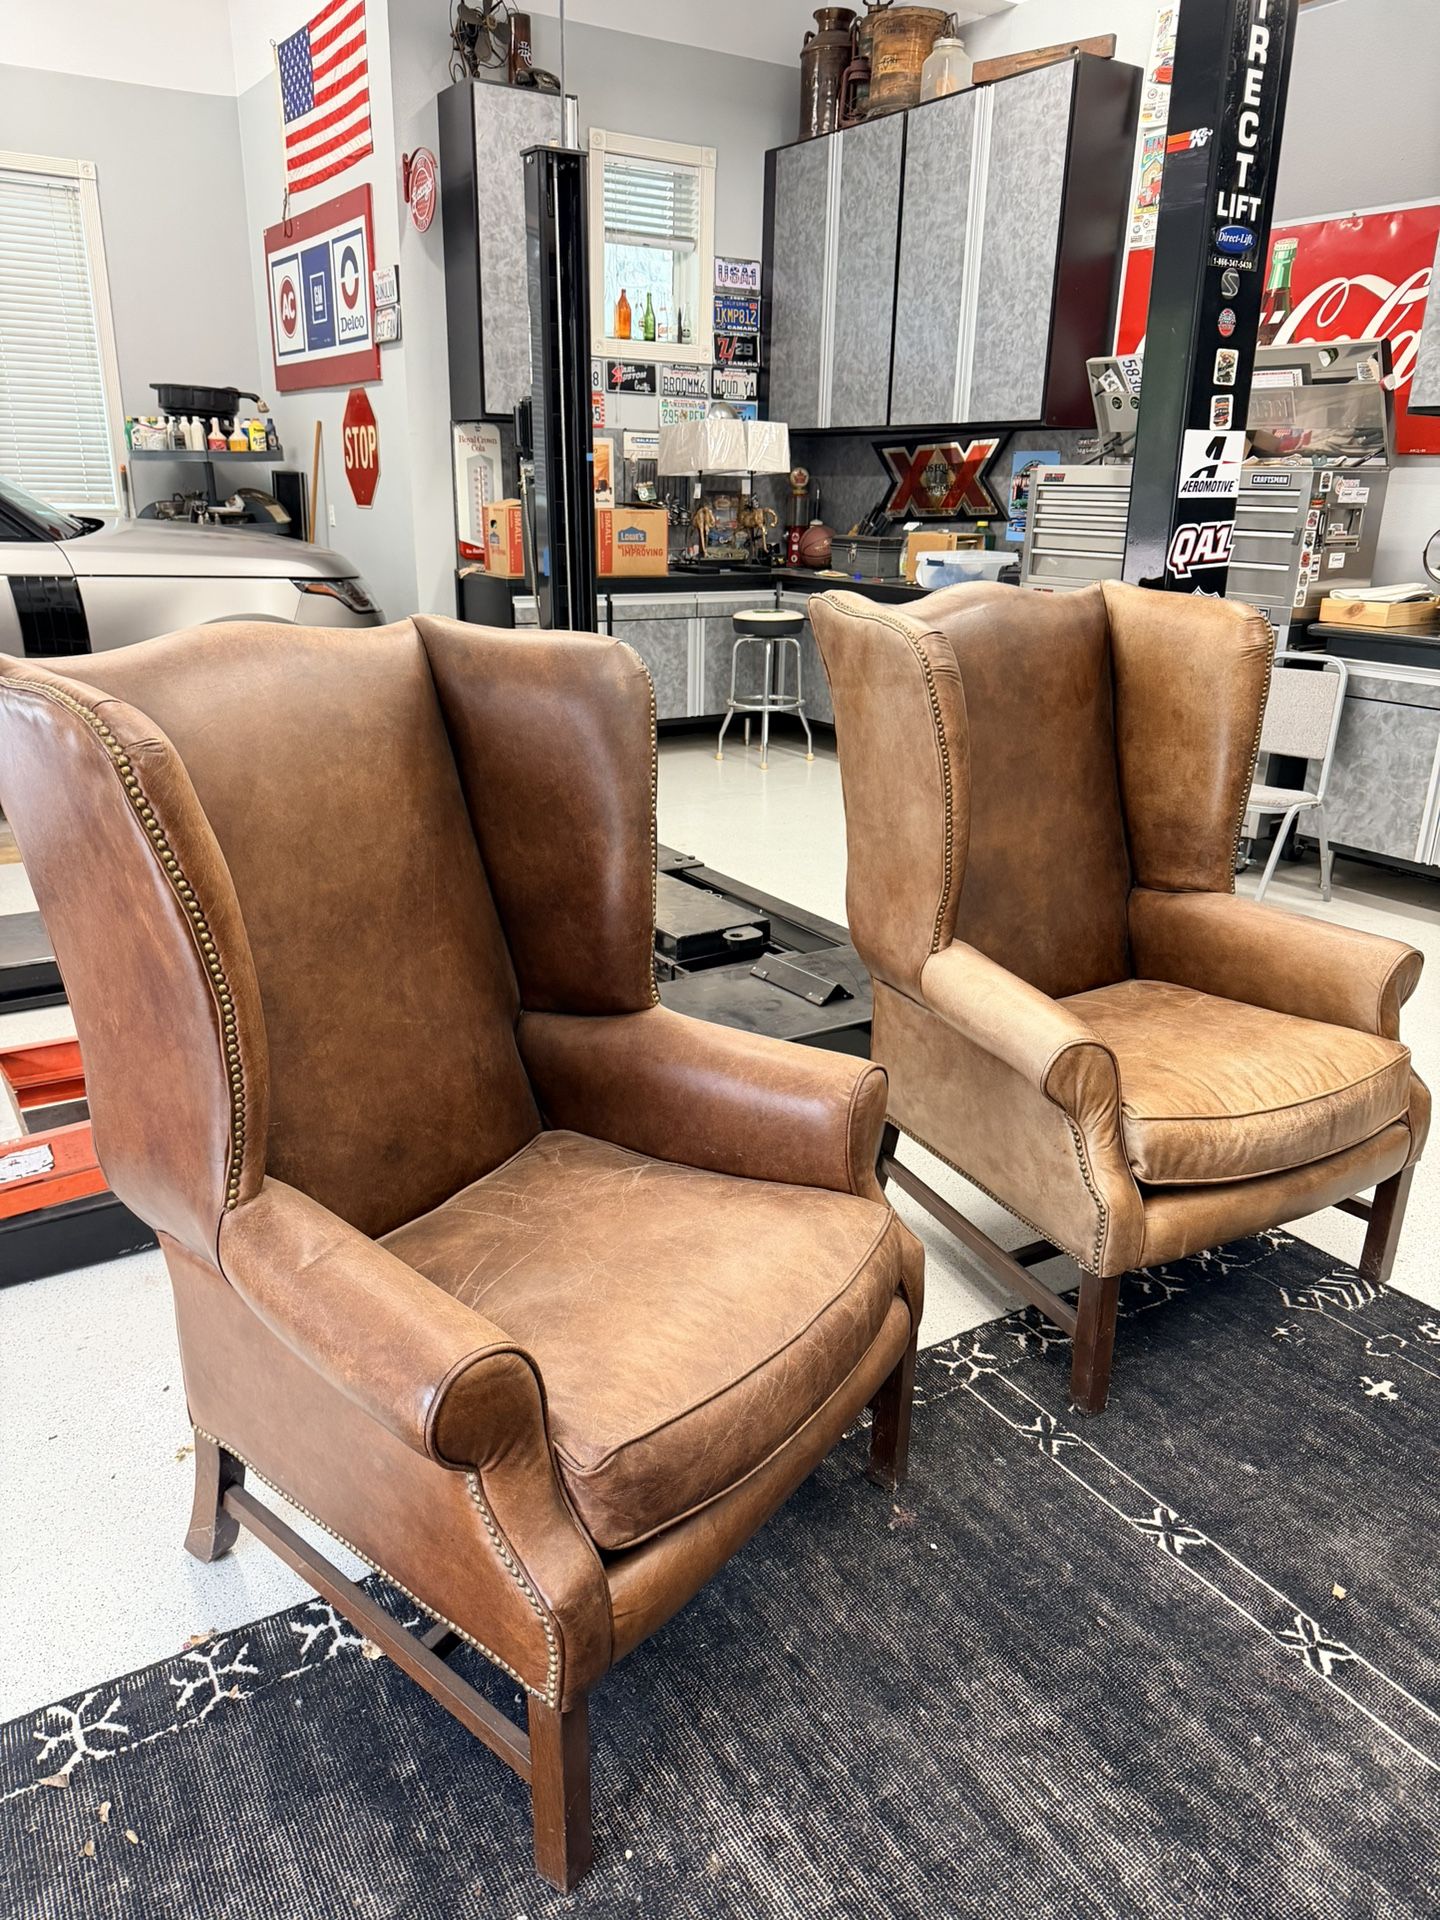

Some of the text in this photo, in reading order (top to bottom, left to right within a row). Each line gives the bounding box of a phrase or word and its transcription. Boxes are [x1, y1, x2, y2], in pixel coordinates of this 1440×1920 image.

[1217, 191, 1261, 222] LIFT
[1217, 231, 1254, 246] Direct-Lift
[718, 264, 757, 286] USA1
[282, 291, 296, 321] AC
[341, 315, 365, 333] Delco
[662, 409, 679, 424] 295
[345, 425, 376, 469] STOP
[458, 435, 498, 445] Royal Crown
[471, 444, 486, 452] Cola
[882, 438, 1000, 517] XX
[1253, 475, 1289, 484] CRAFTSMAN
[1181, 480, 1234, 493] AEROMOTIVE
[621, 548, 664, 557] IMPROVING
[1168, 523, 1236, 577] QA1
